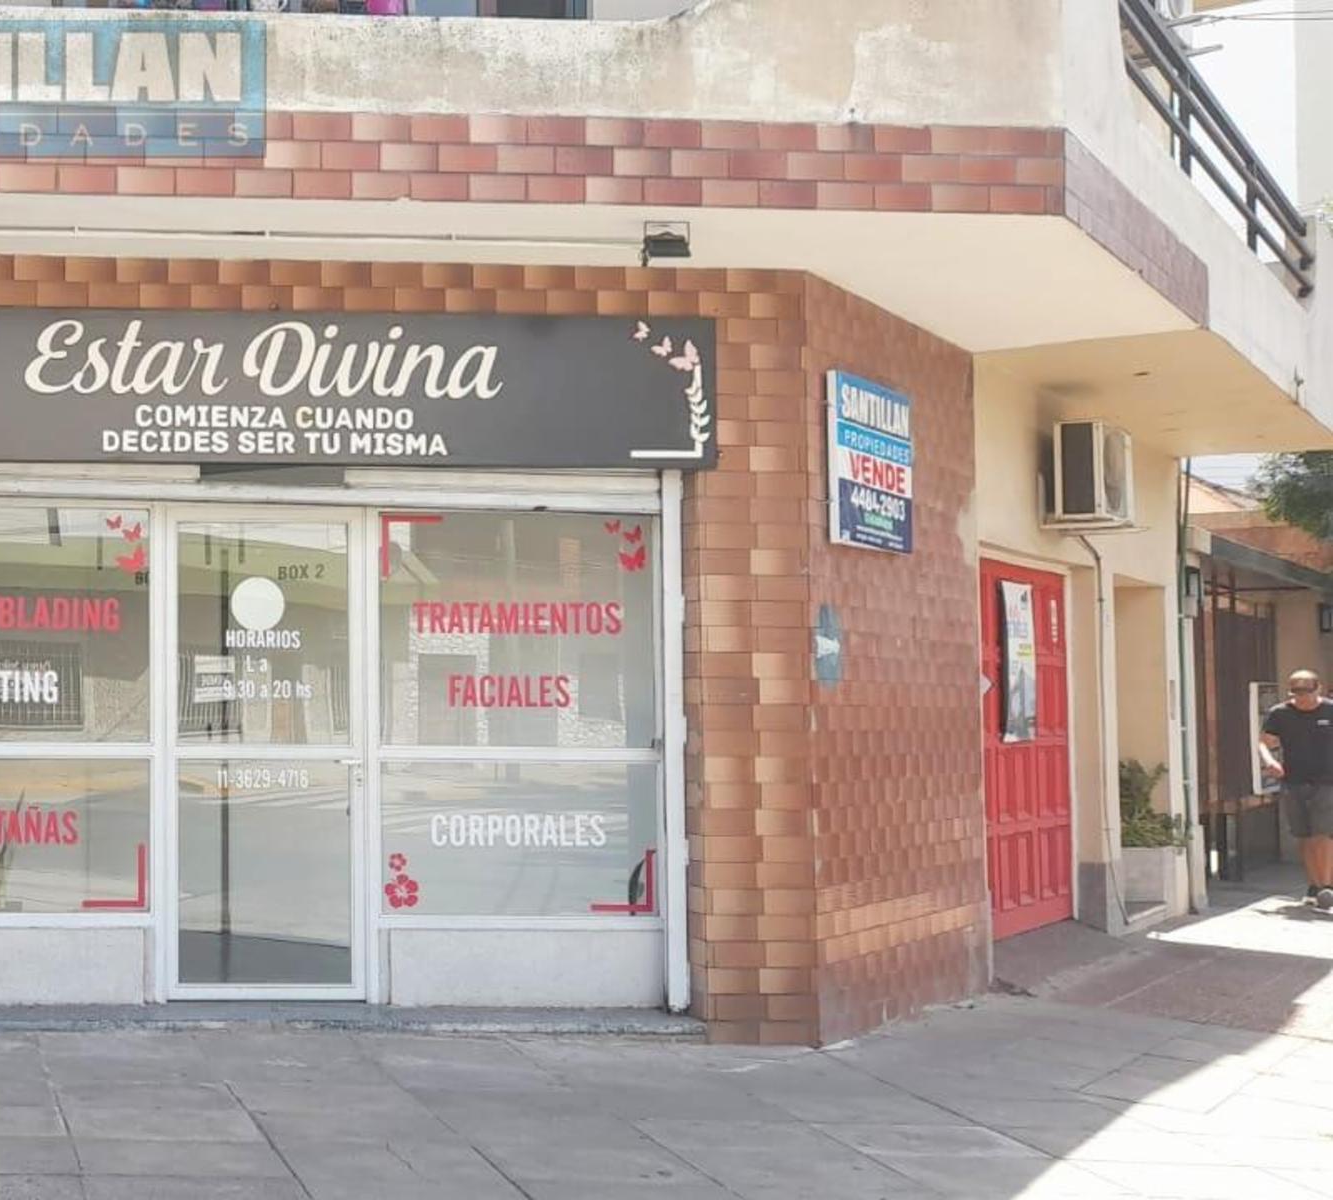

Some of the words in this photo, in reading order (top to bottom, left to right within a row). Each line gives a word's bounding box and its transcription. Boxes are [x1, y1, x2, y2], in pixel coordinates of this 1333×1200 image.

[24, 319, 229, 396] Estar
[242, 321, 503, 399] Divina
[135, 404, 287, 428] COMIENZA
[296, 406, 414, 430] CUANDO
[841, 383, 909, 439] SANTILLAN
[102, 430, 229, 453] DECIDES
[237, 432, 296, 454] SER
[304, 433, 340, 454] TU
[350, 433, 448, 456] MISMA
[844, 429, 910, 463] PROPIEDADES
[848, 451, 906, 495] VENDE
[278, 565, 310, 580] BOX
[315, 564, 326, 579] 2
[413, 602, 623, 634] TRATAMIENTOS
[225, 630, 301, 648] HORARIOS
[273, 680, 291, 698] 20
[296, 680, 312, 698] hs
[448, 675, 571, 708] FACIALES
[217, 769, 309, 788] 11-3629-4716
[431, 814, 606, 847] CORPORALES
